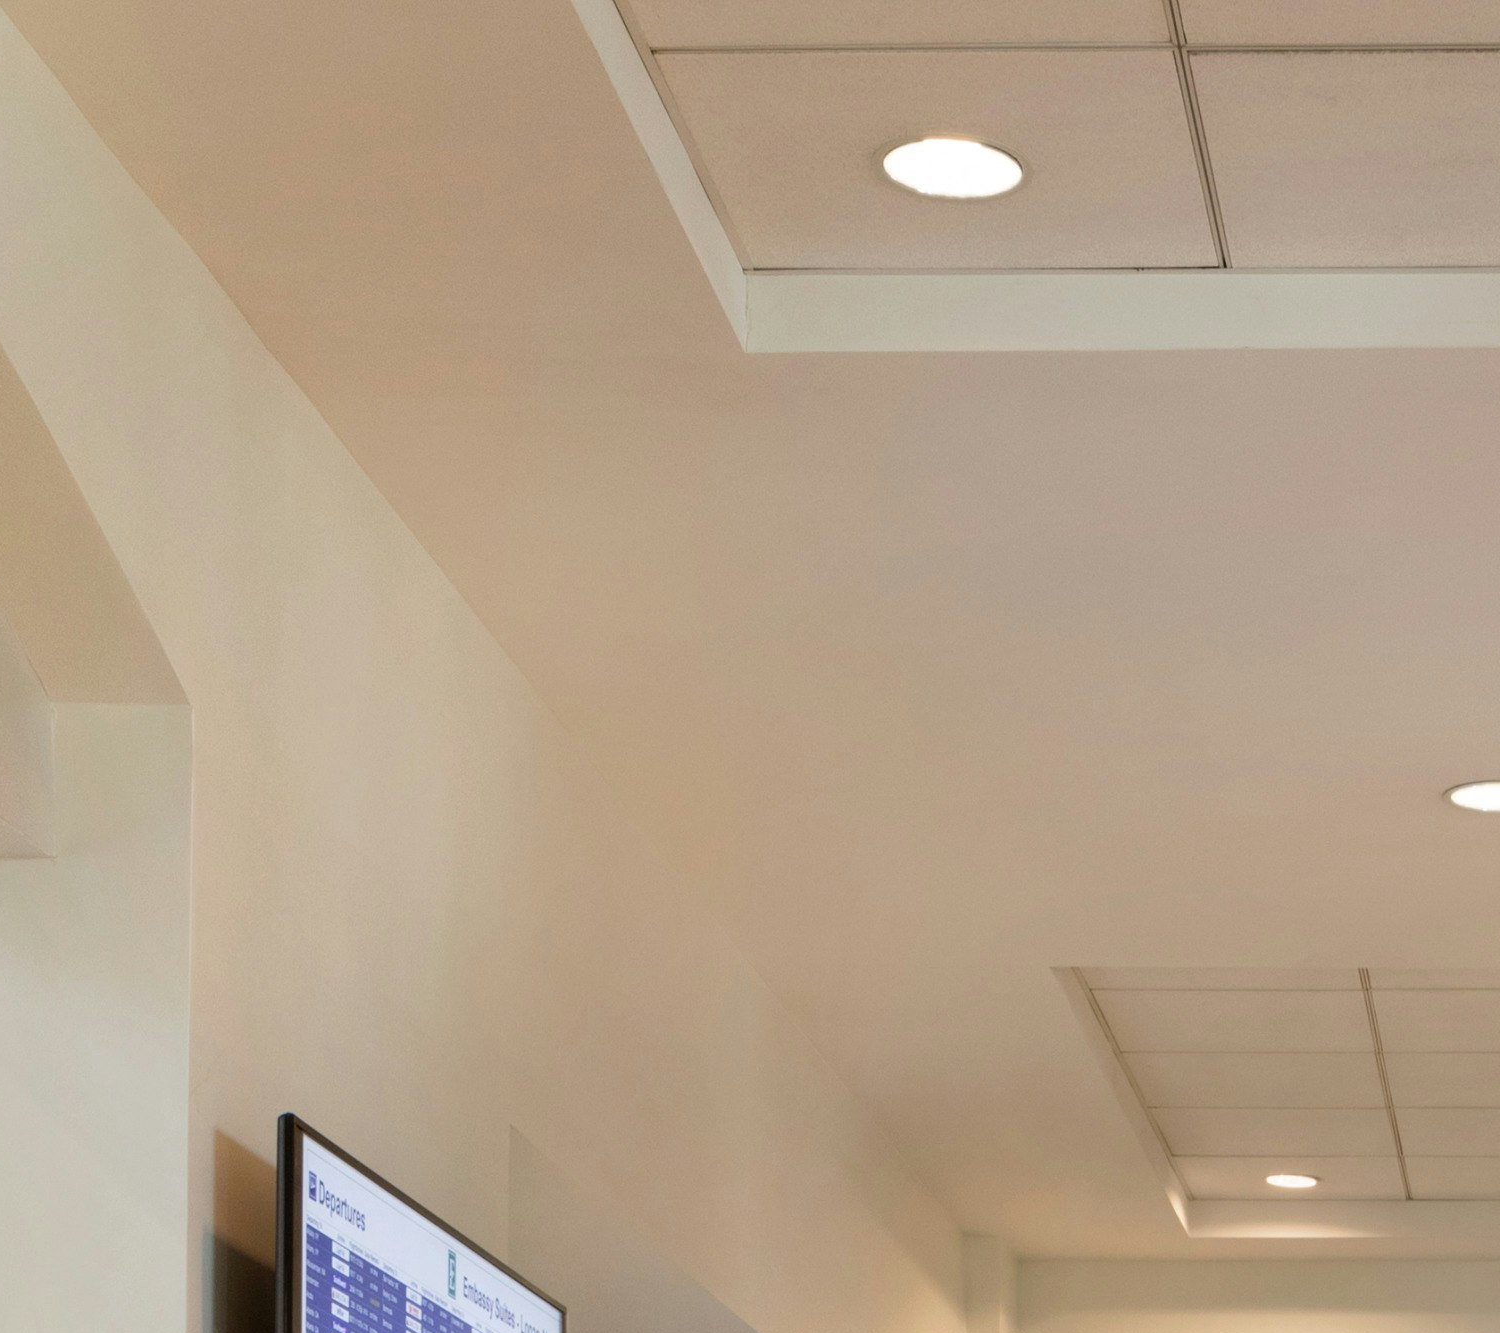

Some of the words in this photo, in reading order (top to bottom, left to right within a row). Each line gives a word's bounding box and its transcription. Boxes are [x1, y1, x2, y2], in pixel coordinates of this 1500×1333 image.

[318, 1180, 366, 1231] Departures
[463, 1275, 494, 1320] Embassy
[495, 1297, 515, 1329] Suites
